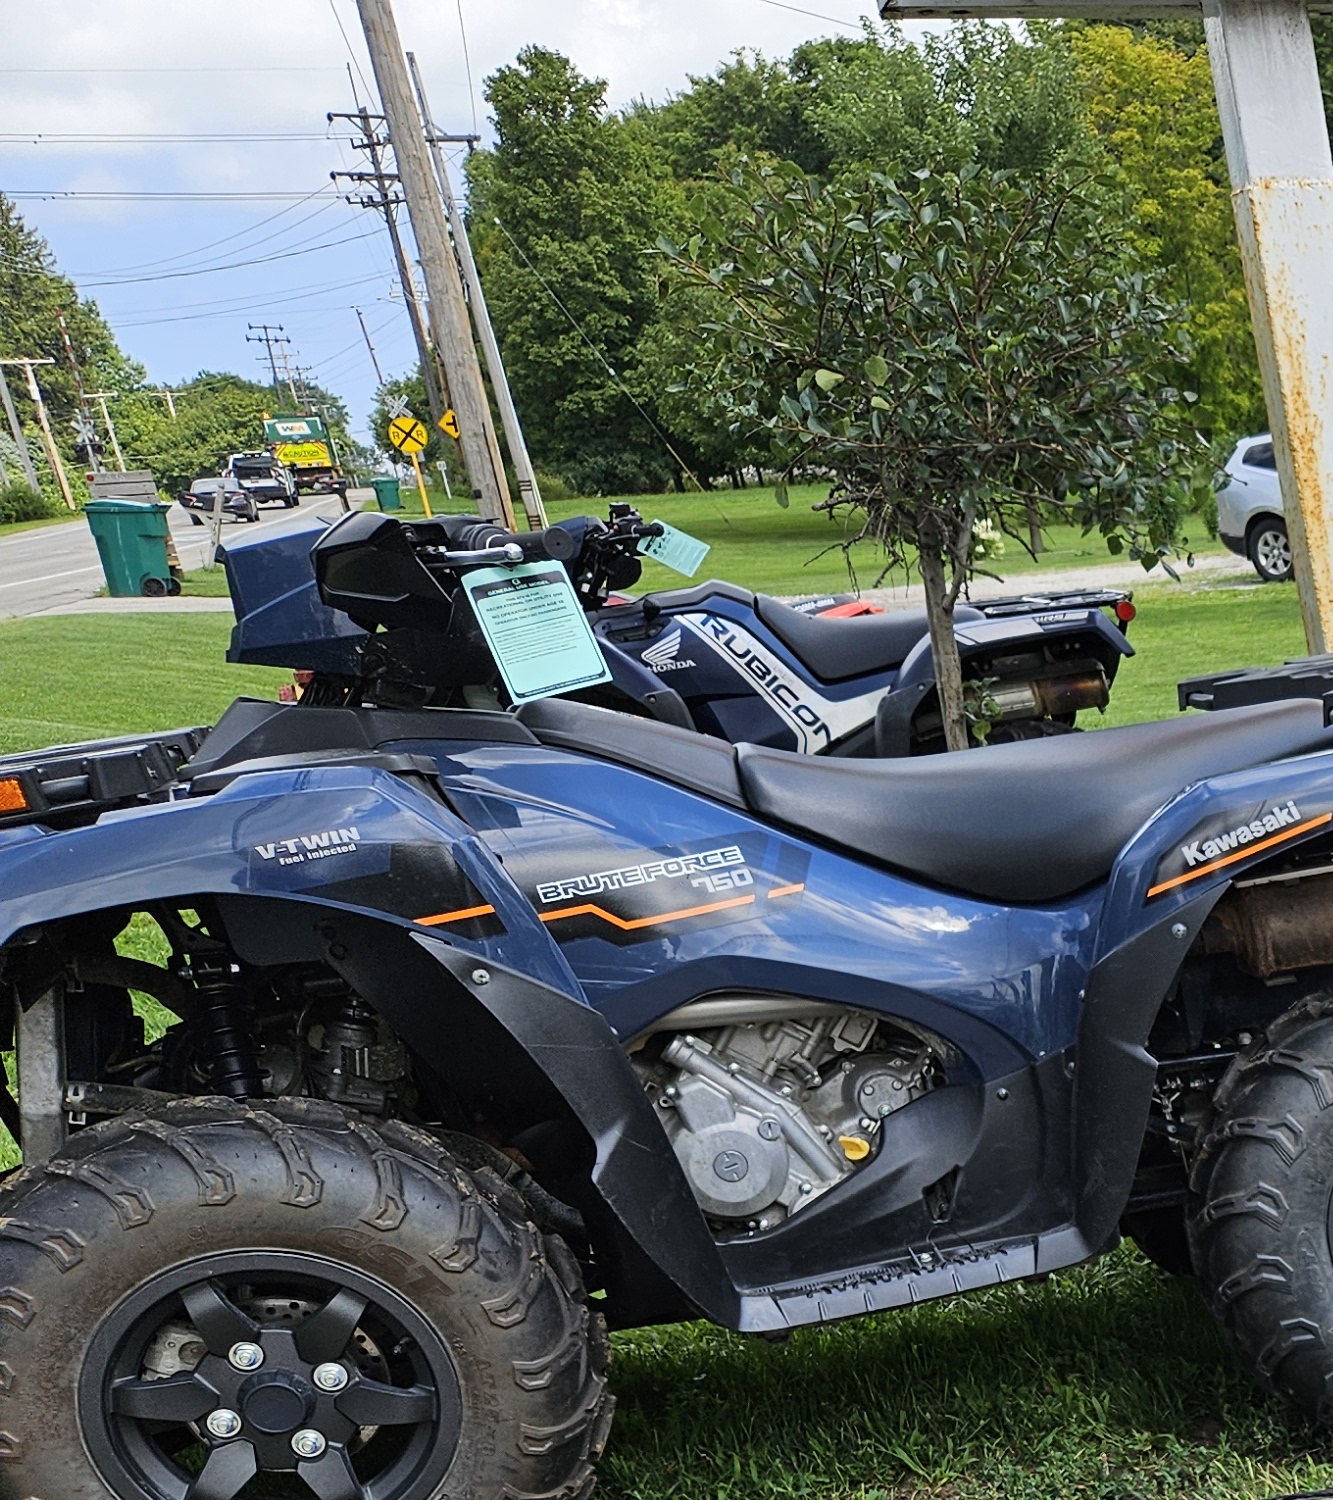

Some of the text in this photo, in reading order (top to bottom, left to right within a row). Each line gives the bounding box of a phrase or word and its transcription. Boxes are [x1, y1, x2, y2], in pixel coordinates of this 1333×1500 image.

[281, 424, 306, 433] WM
[392, 430, 424, 440] R R
[487, 587, 515, 596] GENERAL
[648, 660, 696, 674] HONDA
[700, 616, 831, 744] RUBICON
[255, 827, 361, 860] V-TWIN
[1181, 800, 1301, 867] Kawasaki
[279, 843, 357, 866] Fuel Injected
[536, 846, 745, 903] BRUTE FORCE
[691, 868, 754, 893] 750
[316, 1226, 453, 1297] CST
